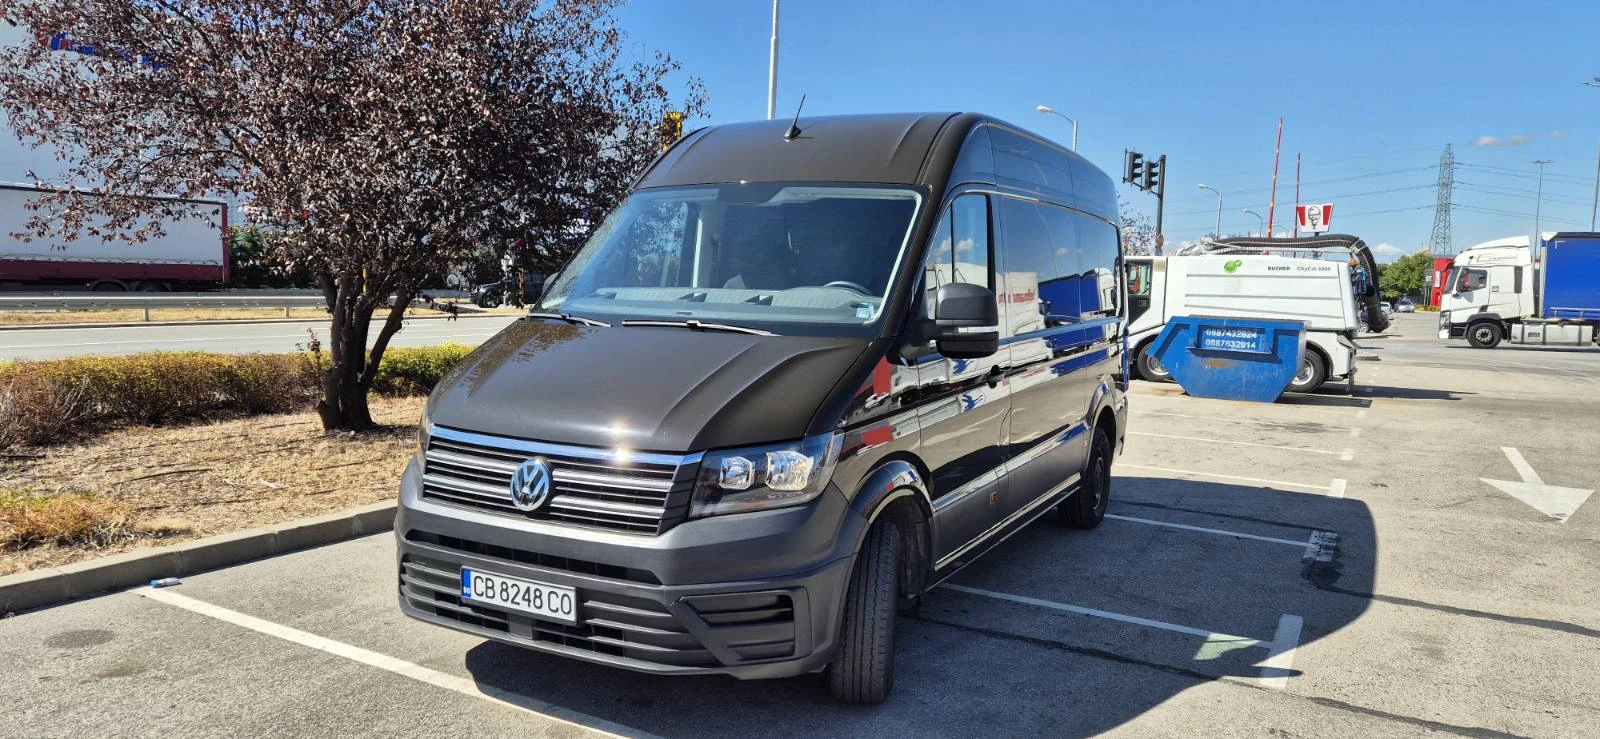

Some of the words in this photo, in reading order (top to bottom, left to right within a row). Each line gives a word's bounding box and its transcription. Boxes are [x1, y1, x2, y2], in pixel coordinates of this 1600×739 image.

[473, 575, 495, 599] CB
[500, 581, 543, 609] 8248
[547, 590, 572, 615] CO
